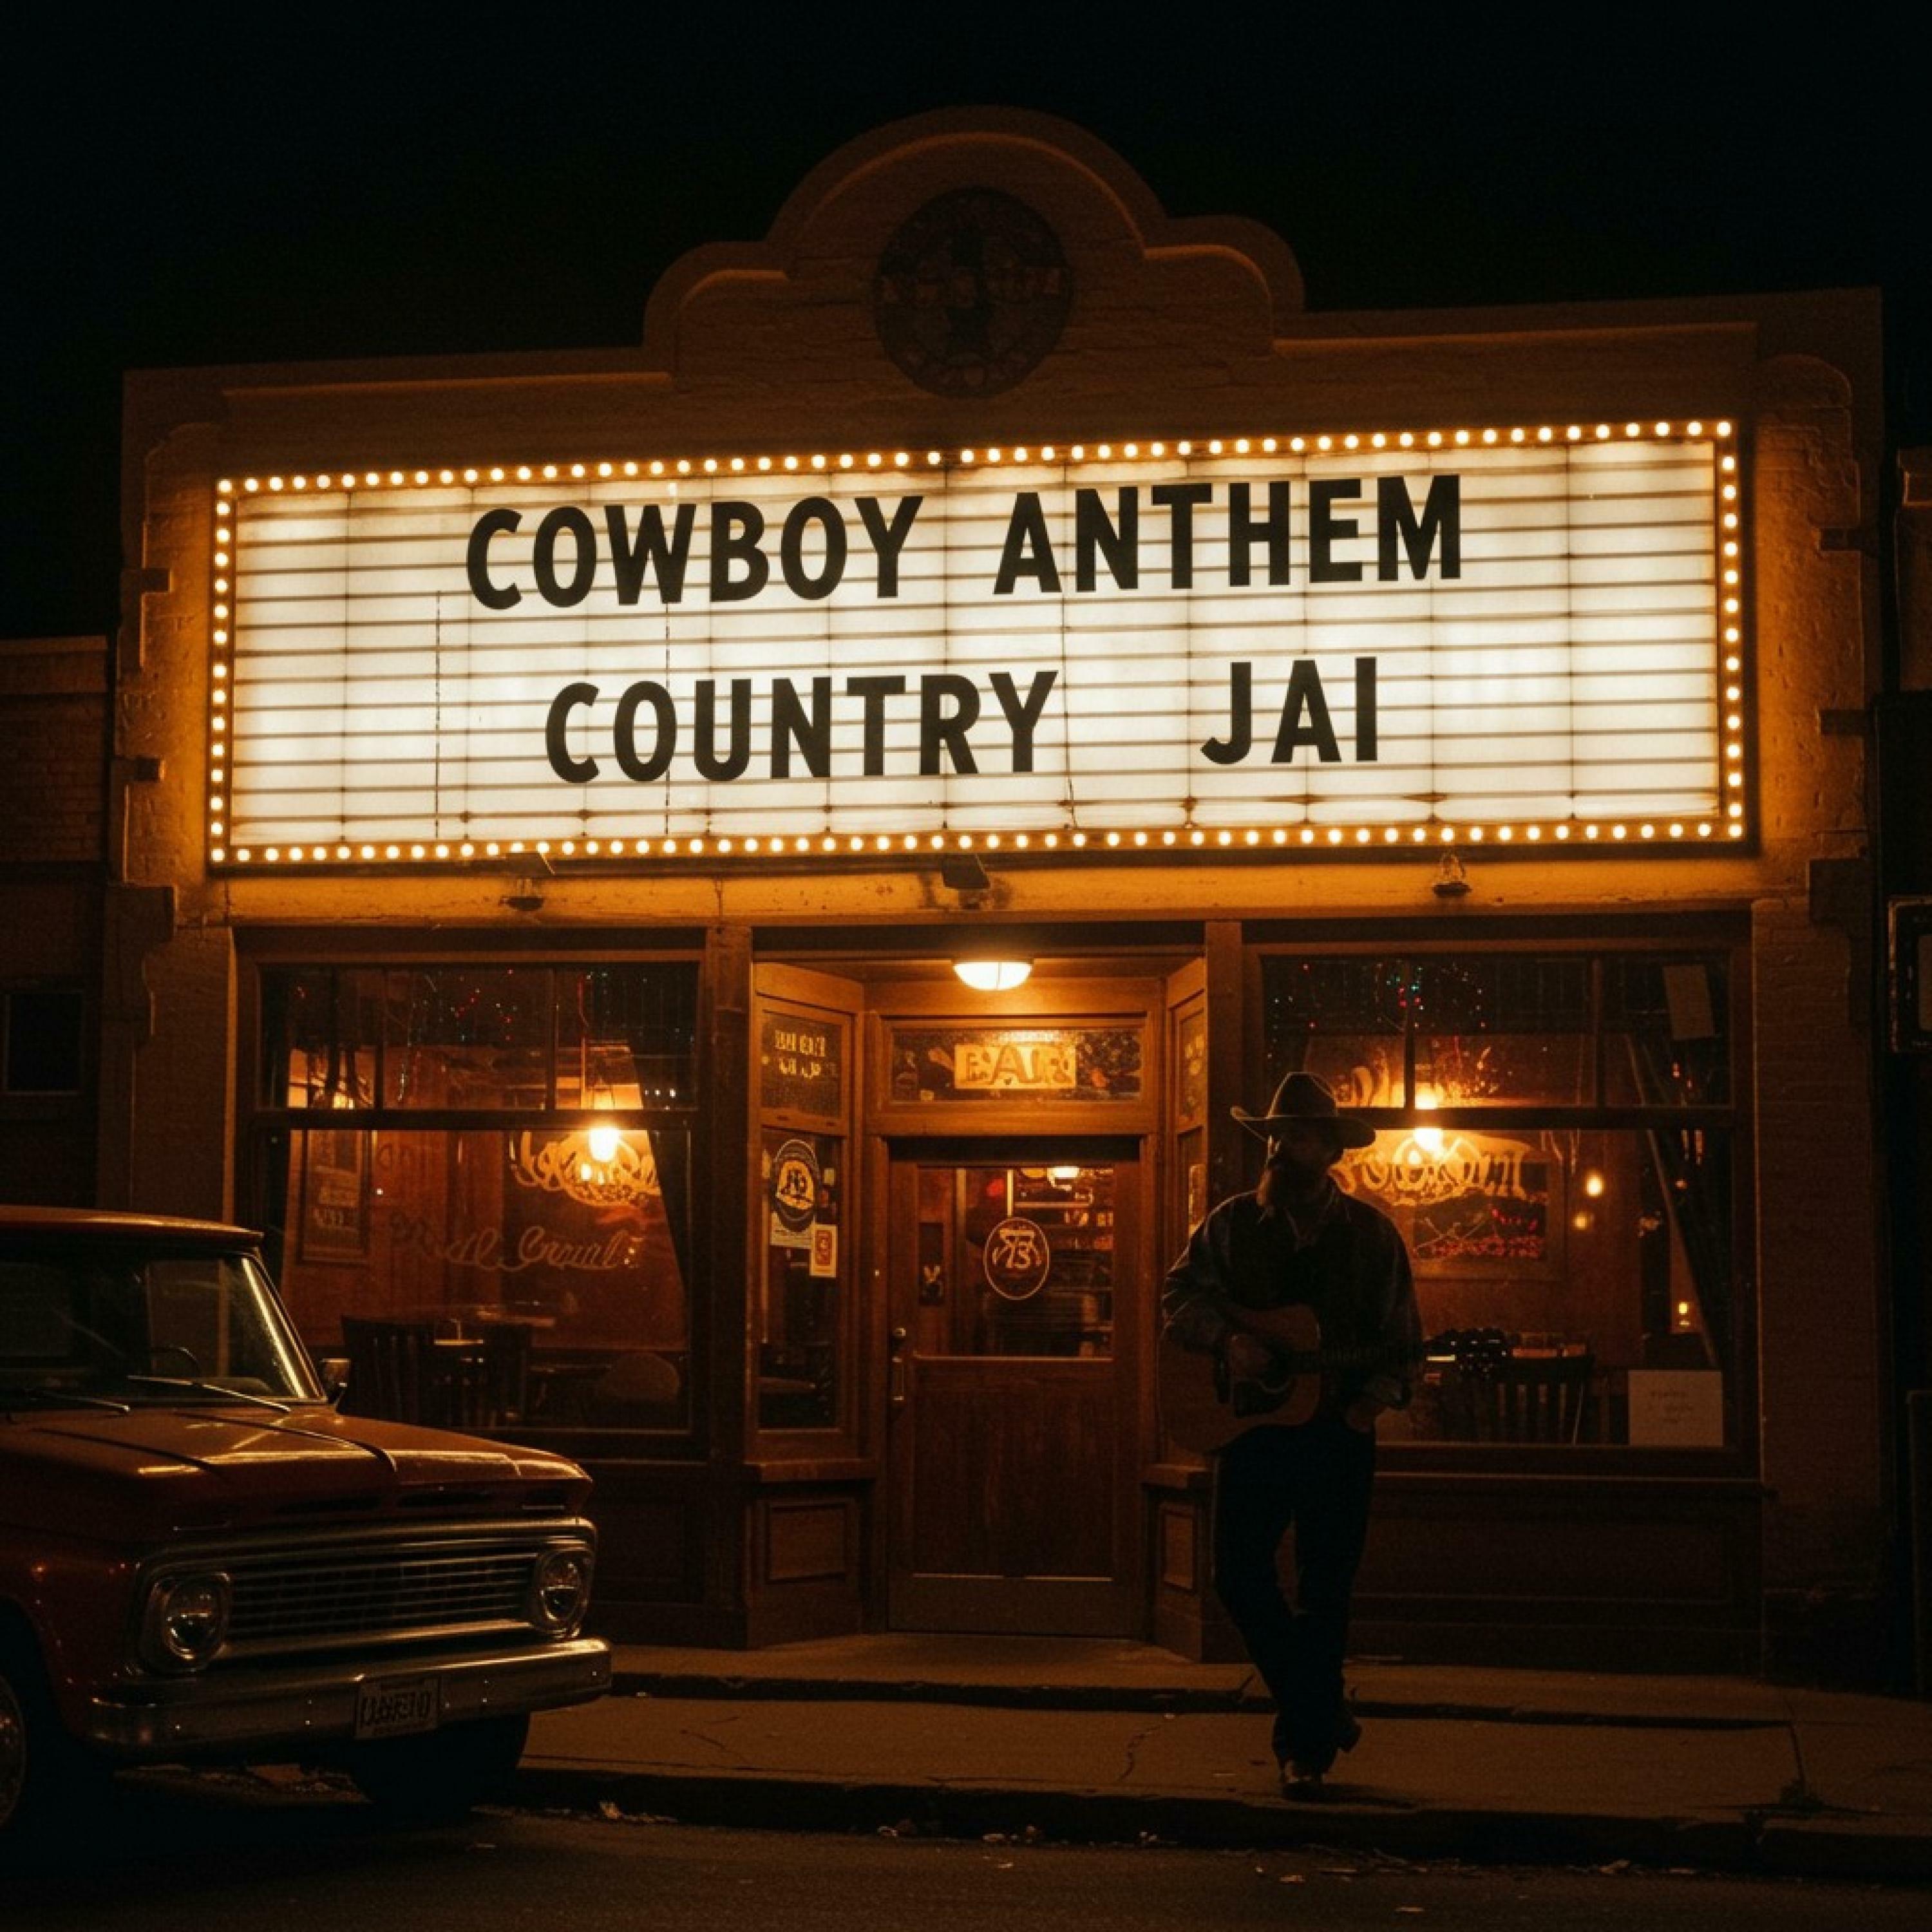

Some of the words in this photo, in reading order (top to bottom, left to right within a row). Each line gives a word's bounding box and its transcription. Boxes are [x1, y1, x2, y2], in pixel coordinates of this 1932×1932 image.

[466, 495, 924, 610] COWBOY
[993, 474, 1461, 595] ANTHEM
[545, 671, 1057, 784] COUNTRY
[1200, 657, 1378, 764] JAI
